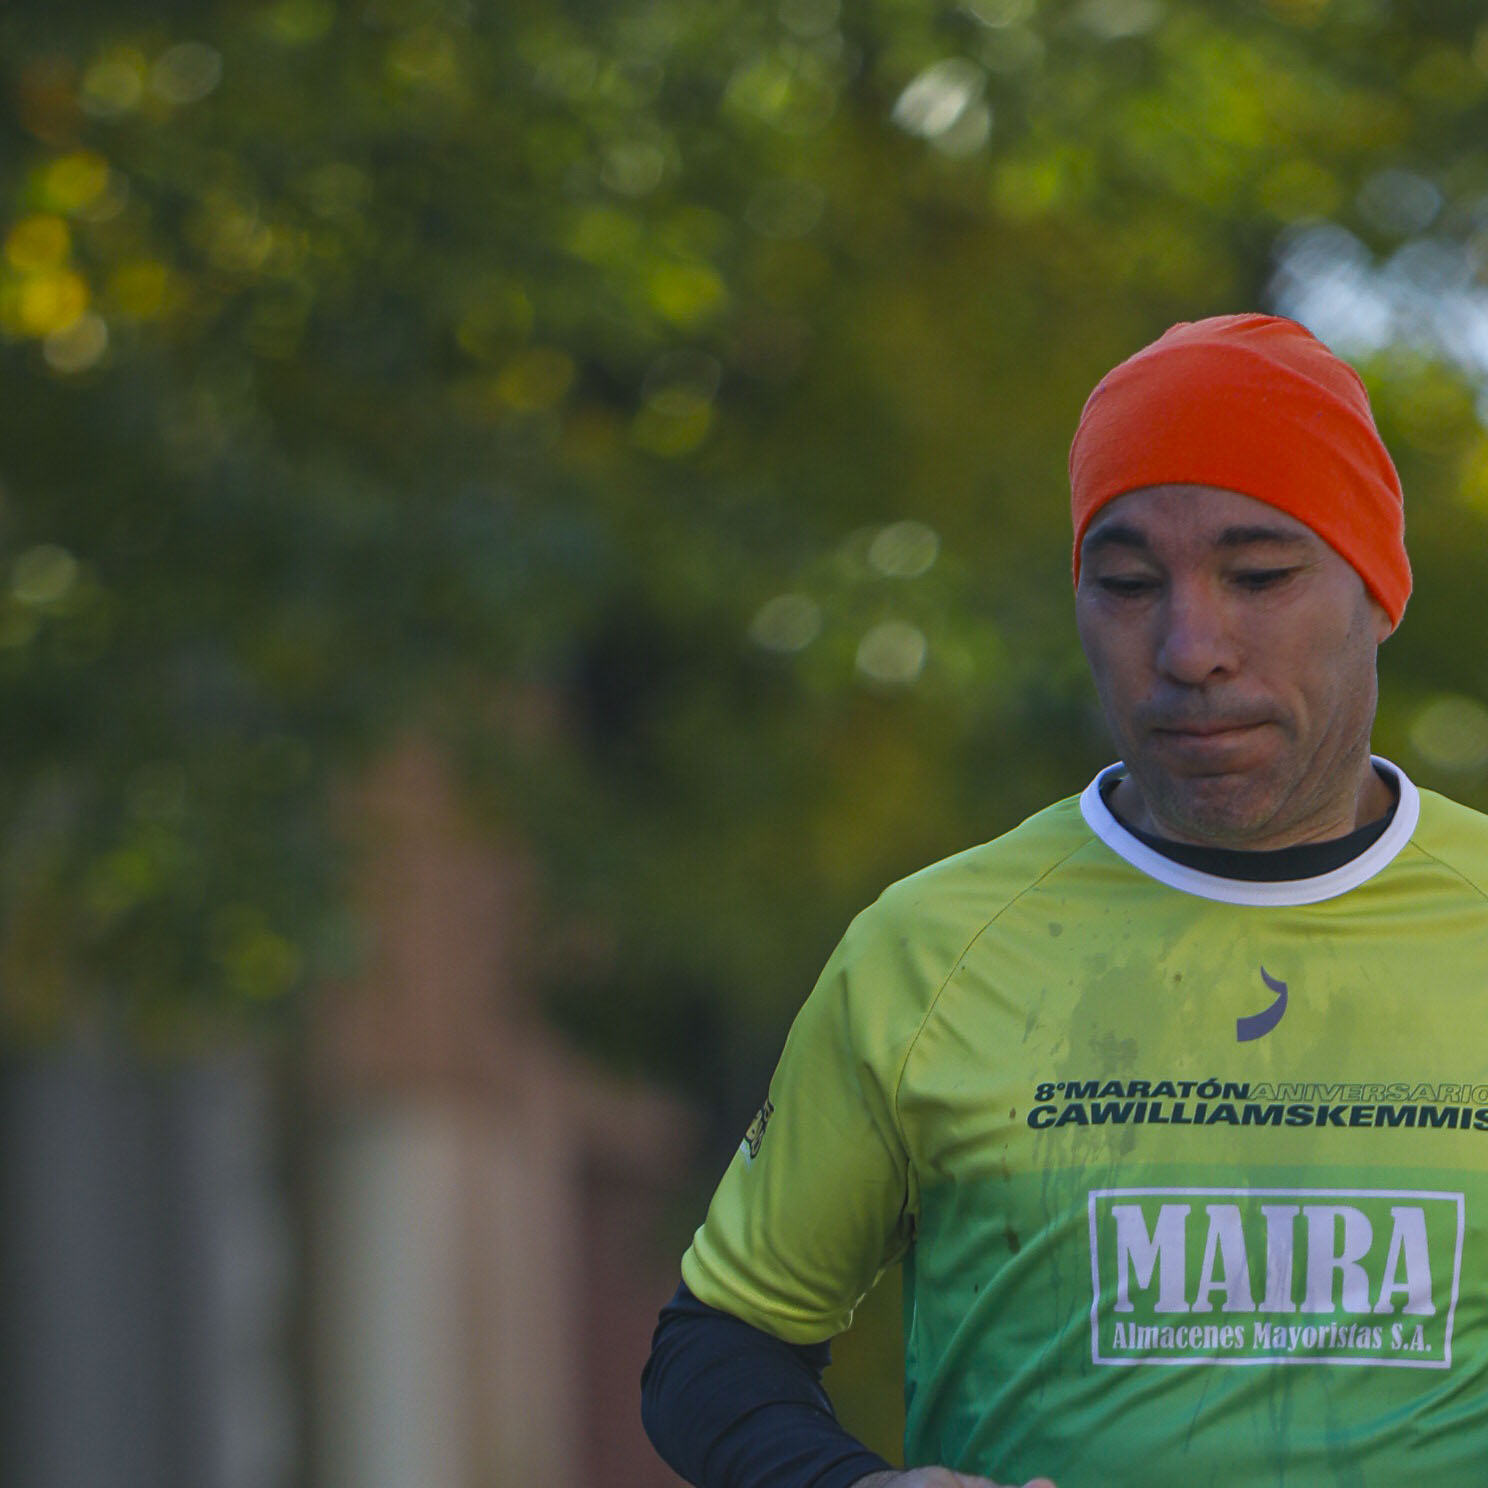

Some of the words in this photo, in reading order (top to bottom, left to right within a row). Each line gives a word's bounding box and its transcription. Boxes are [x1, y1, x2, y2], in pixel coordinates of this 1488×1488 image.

[1111, 1204, 1437, 1315] MAIRA
[1113, 1321, 1245, 1350] Almacenes
[1253, 1321, 1383, 1351] Mayoristas
[1391, 1323, 1432, 1352] S.A.
